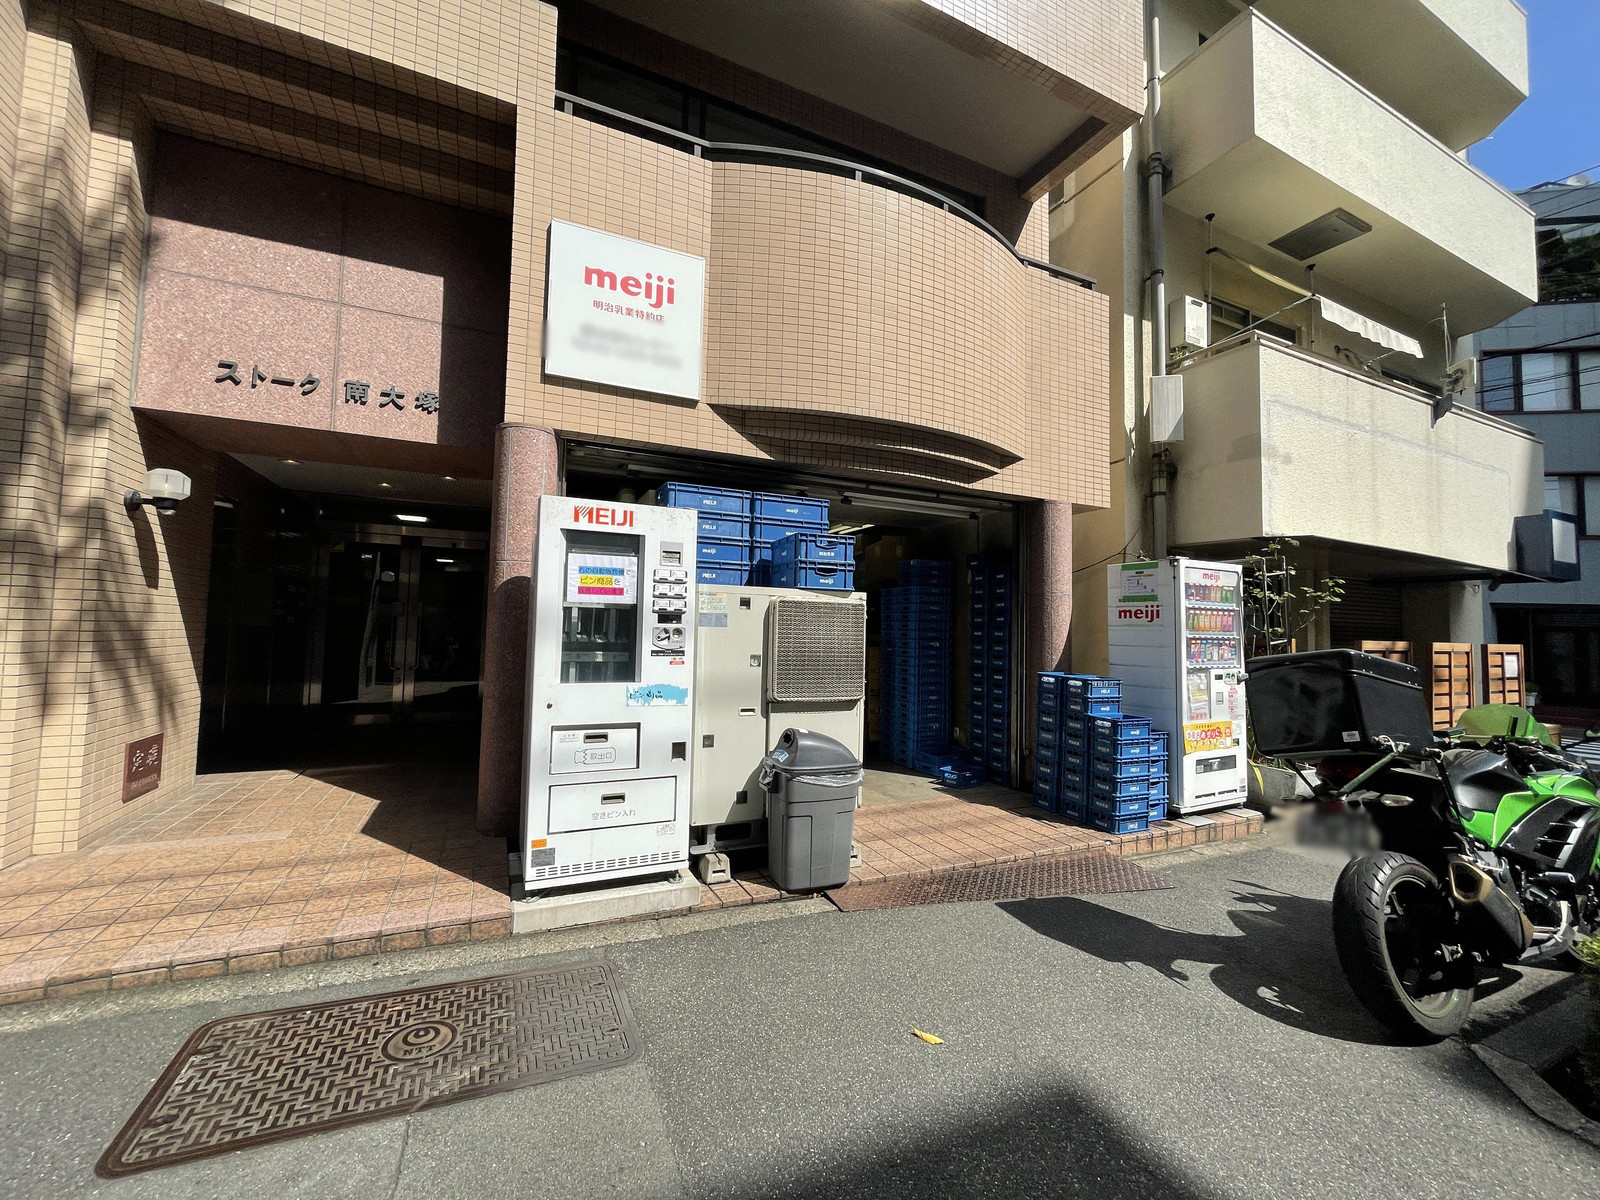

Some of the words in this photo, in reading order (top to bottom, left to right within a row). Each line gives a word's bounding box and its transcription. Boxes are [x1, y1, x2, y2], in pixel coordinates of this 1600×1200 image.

[584, 265, 675, 309] meiji
[592, 299, 665, 322] 明治乳業特約店
[214, 359, 321, 397] ストーク
[343, 379, 440, 415] 南大塚
[573, 504, 634, 528] MEIJI
[580, 576, 621, 586] ビン商品を
[1202, 572, 1220, 582] meiji
[1118, 604, 1160, 623] meiji
[590, 752, 612, 760] 取出口
[592, 810, 636, 821] 空きビン入れ
[402, 1044, 437, 1056] NTT
